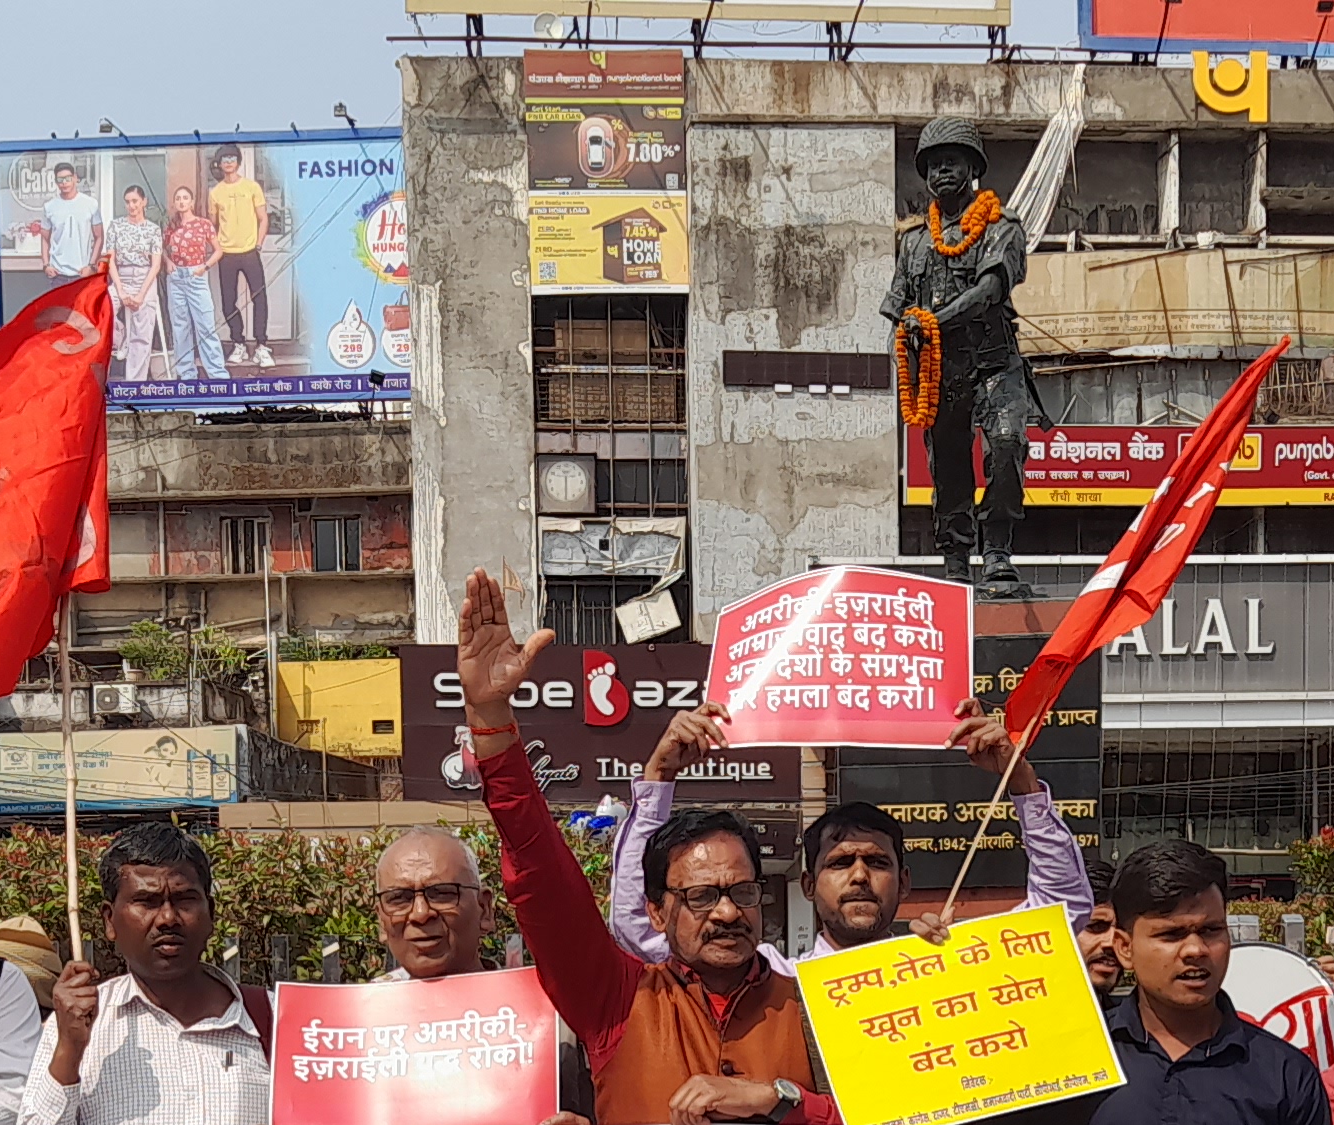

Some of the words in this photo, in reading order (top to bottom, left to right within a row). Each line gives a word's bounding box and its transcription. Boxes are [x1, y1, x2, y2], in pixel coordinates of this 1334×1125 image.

[298, 158, 394, 178] FASHION
[623, 239, 661, 252] HOME
[623, 252, 662, 265] LOAN
[211, 384, 227, 394] पास
[1050, 432, 1121, 463] नैशनल
[1128, 431, 1164, 461] बैंक
[1275, 436, 1334, 466] punjab
[597, 758, 644, 780] The
[956, 935, 990, 965] के
[1000, 929, 1055, 958] लिए
[859, 1005, 922, 1042] खून
[932, 991, 979, 1020] का
[988, 974, 1049, 1006] खेल
[302, 1019, 366, 1053] ईरान
[373, 1024, 408, 1048] पर
[414, 1006, 527, 1044] अमरीकी-
[292, 1049, 410, 1082] इज़राईली
[470, 1035, 535, 1070] रोको!
[909, 1042, 957, 1073] बंद
[965, 1020, 1029, 1058] करो
